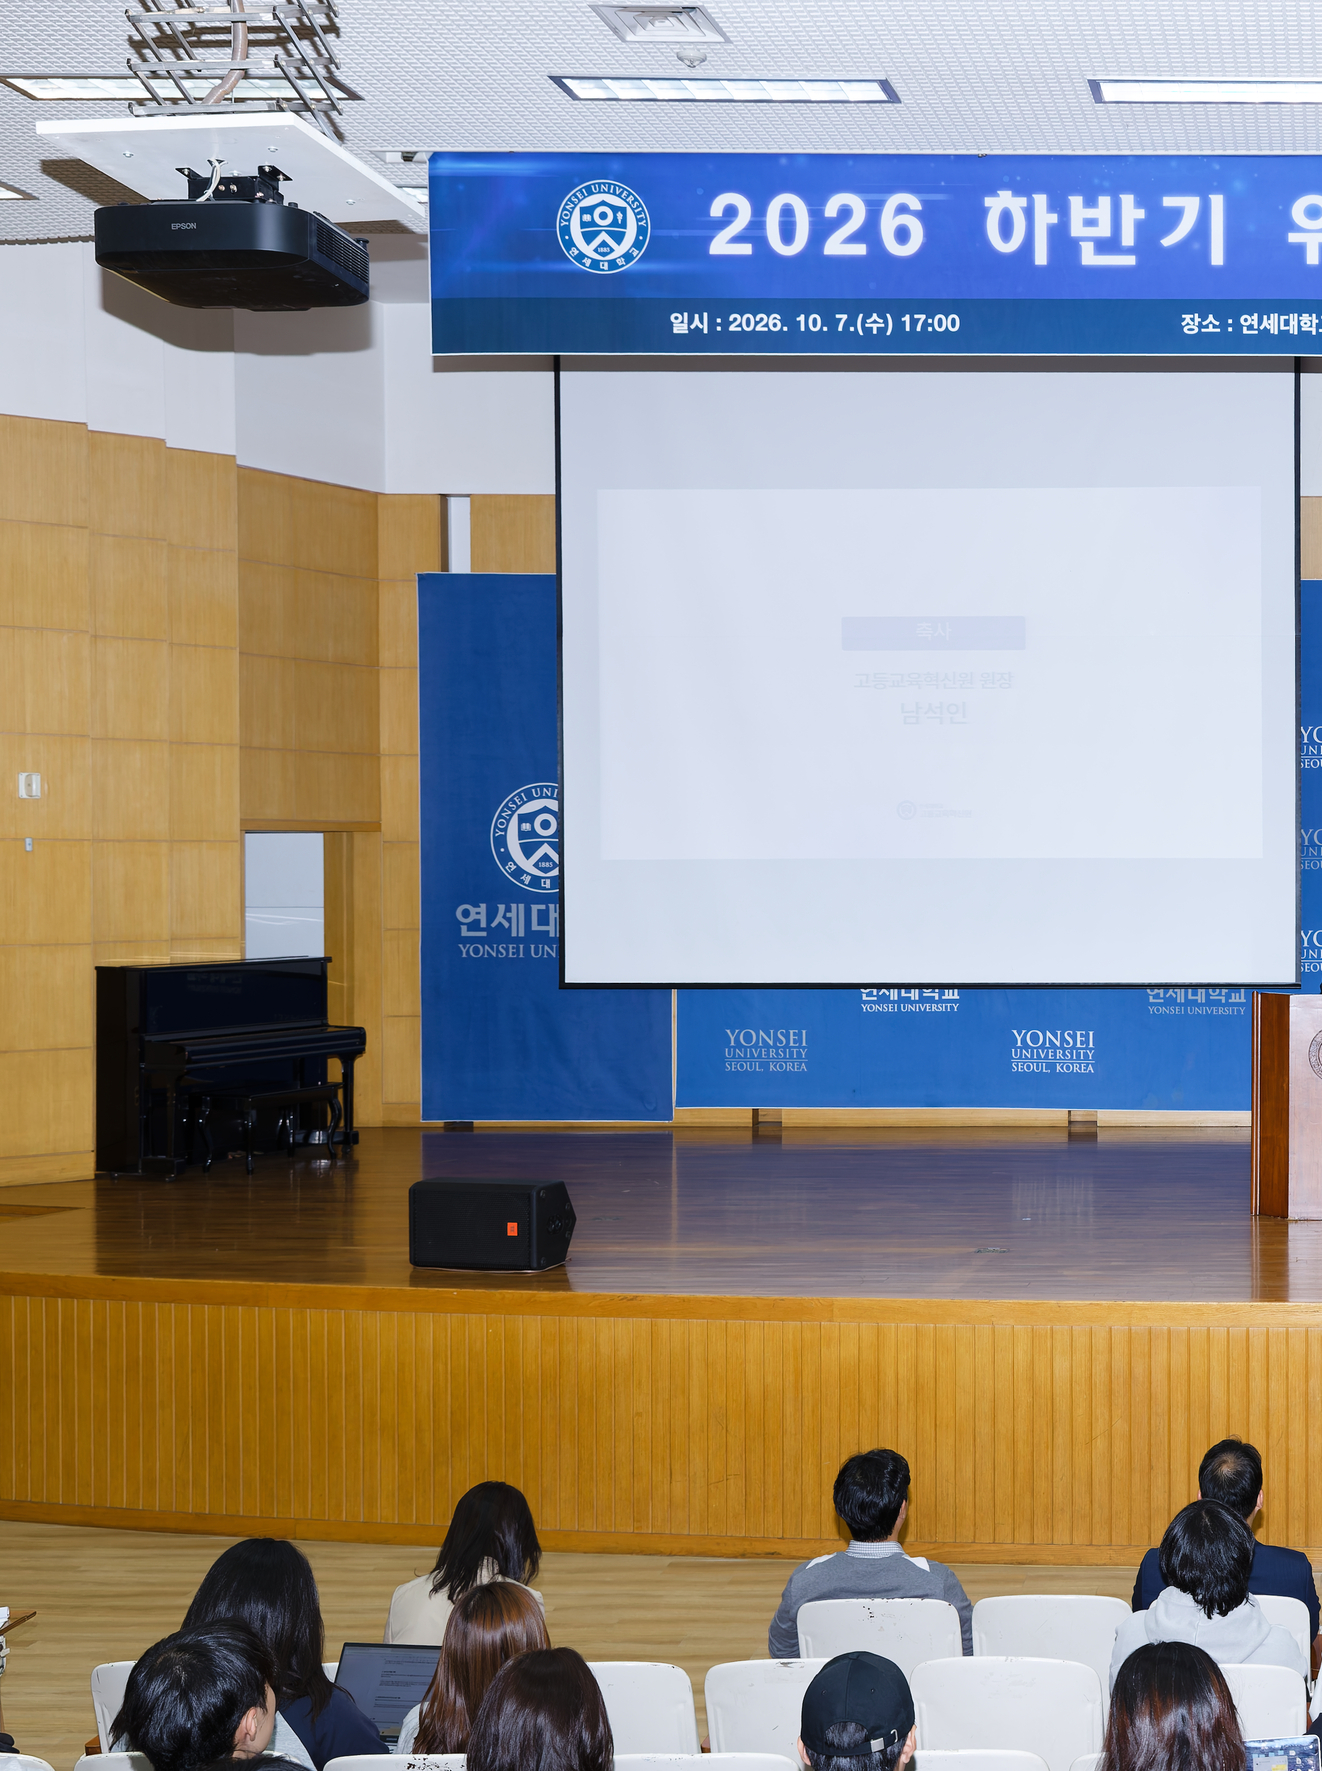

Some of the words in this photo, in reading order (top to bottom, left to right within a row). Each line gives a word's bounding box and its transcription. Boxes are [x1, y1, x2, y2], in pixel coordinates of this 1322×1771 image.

[560, 188, 588, 227] YONSEI
[591, 184, 647, 227] UNIVERSITY
[171, 222, 197, 230] EPSON
[708, 192, 924, 257] 2026
[984, 190, 1225, 266] 하반기
[669, 312, 708, 334] 일시
[728, 313, 788, 332] 2026.
[796, 313, 828, 332] 10.
[835, 312, 893, 336] 7.(수)
[901, 313, 961, 332] 17:00
[1180, 312, 1221, 335] 장소
[915, 621, 952, 641] 축사
[853, 671, 975, 690] 고등교육혁신원
[979, 671, 1014, 690] 원장
[900, 701, 968, 725] 남석인
[494, 793, 527, 837] YONSEI
[505, 861, 551, 889] 연세대
[455, 903, 559, 938] 연세대
[458, 944, 525, 958] YONSEI
[861, 1004, 898, 1012] YONSEI
[901, 1004, 960, 1012] UNIVERSITY
[1148, 1006, 1185, 1015] YONSEI
[1187, 1006, 1246, 1015] UNIVERSITY
[725, 1029, 808, 1047] YONSEI
[1011, 1029, 1095, 1048] YONSEI
[725, 1048, 808, 1058] UNIVERSITY
[1011, 1049, 1095, 1060] UNIVERSITY
[725, 1062, 764, 1072] SEOUL,
[769, 1062, 808, 1072] KOREA
[1011, 1063, 1050, 1073] SEOUL,
[1056, 1063, 1095, 1073] KOREA
